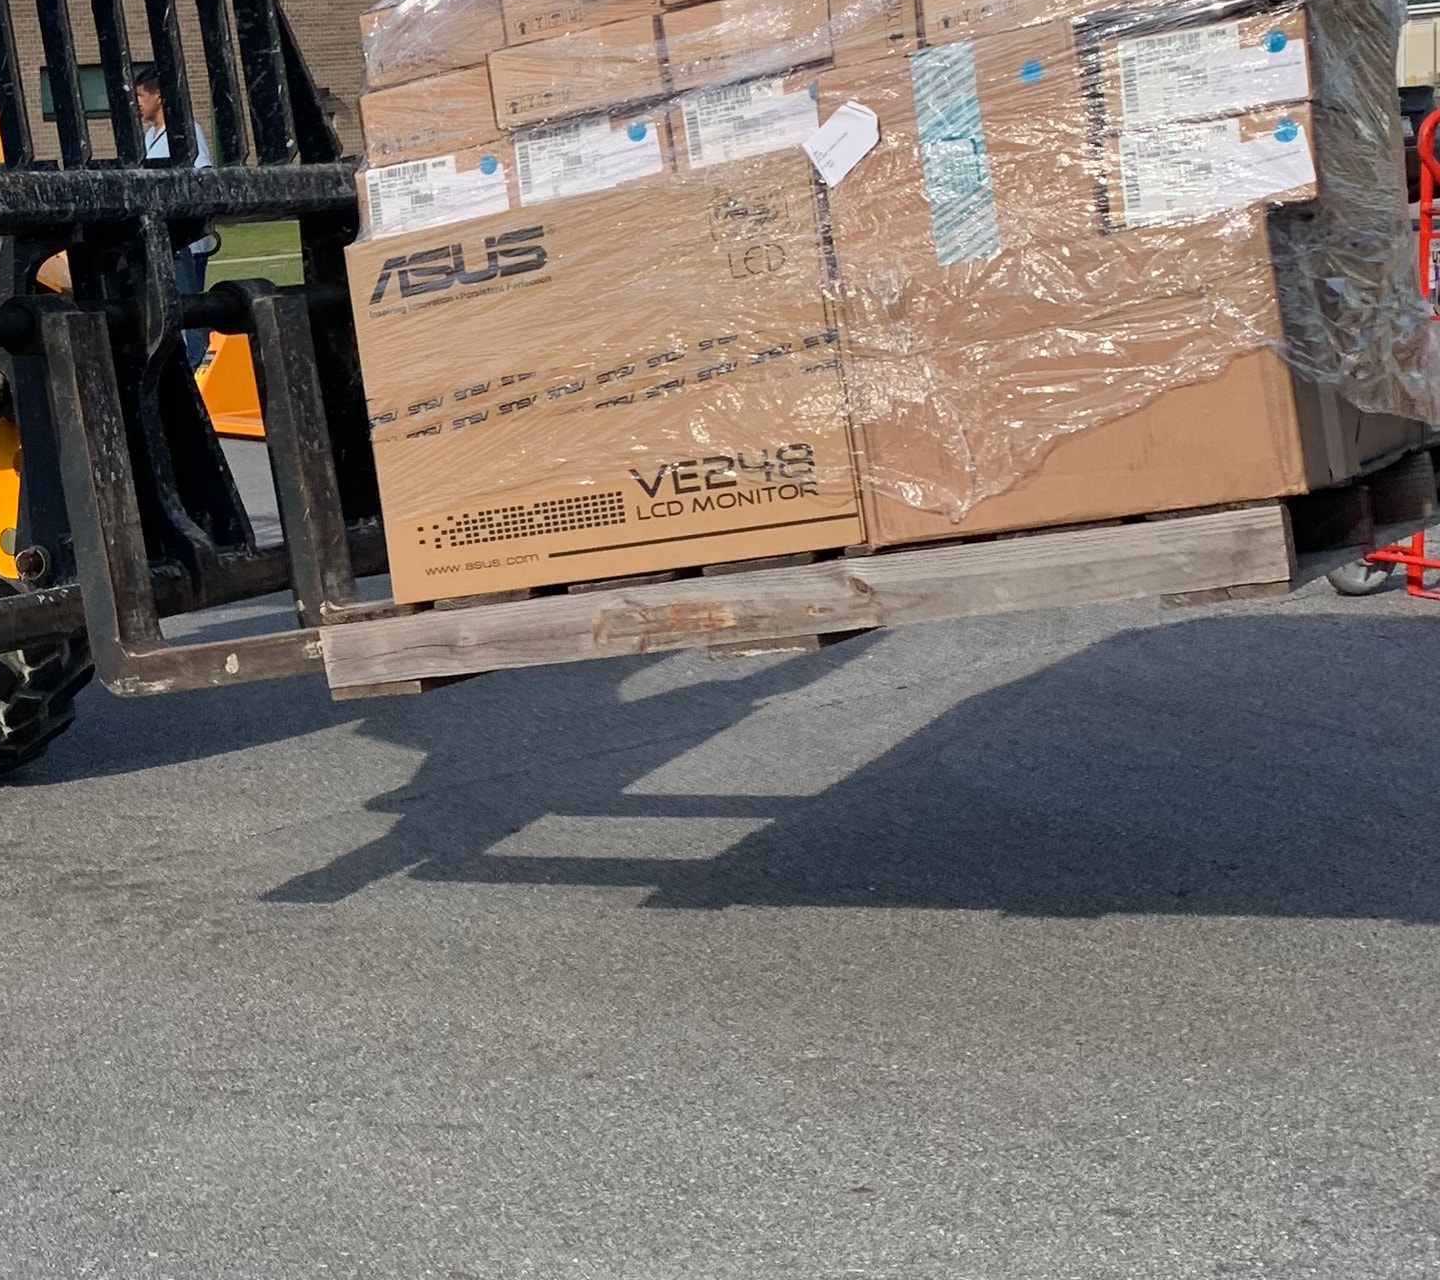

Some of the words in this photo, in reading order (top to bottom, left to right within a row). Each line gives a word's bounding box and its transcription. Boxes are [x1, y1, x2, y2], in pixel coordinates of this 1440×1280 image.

[369, 225, 548, 305] ASUS
[728, 243, 786, 278] LED
[629, 443, 815, 498] VE248
[636, 500, 684, 520] LCD
[691, 481, 820, 513] MONITOR
[425, 553, 539, 576] www.asus.com
